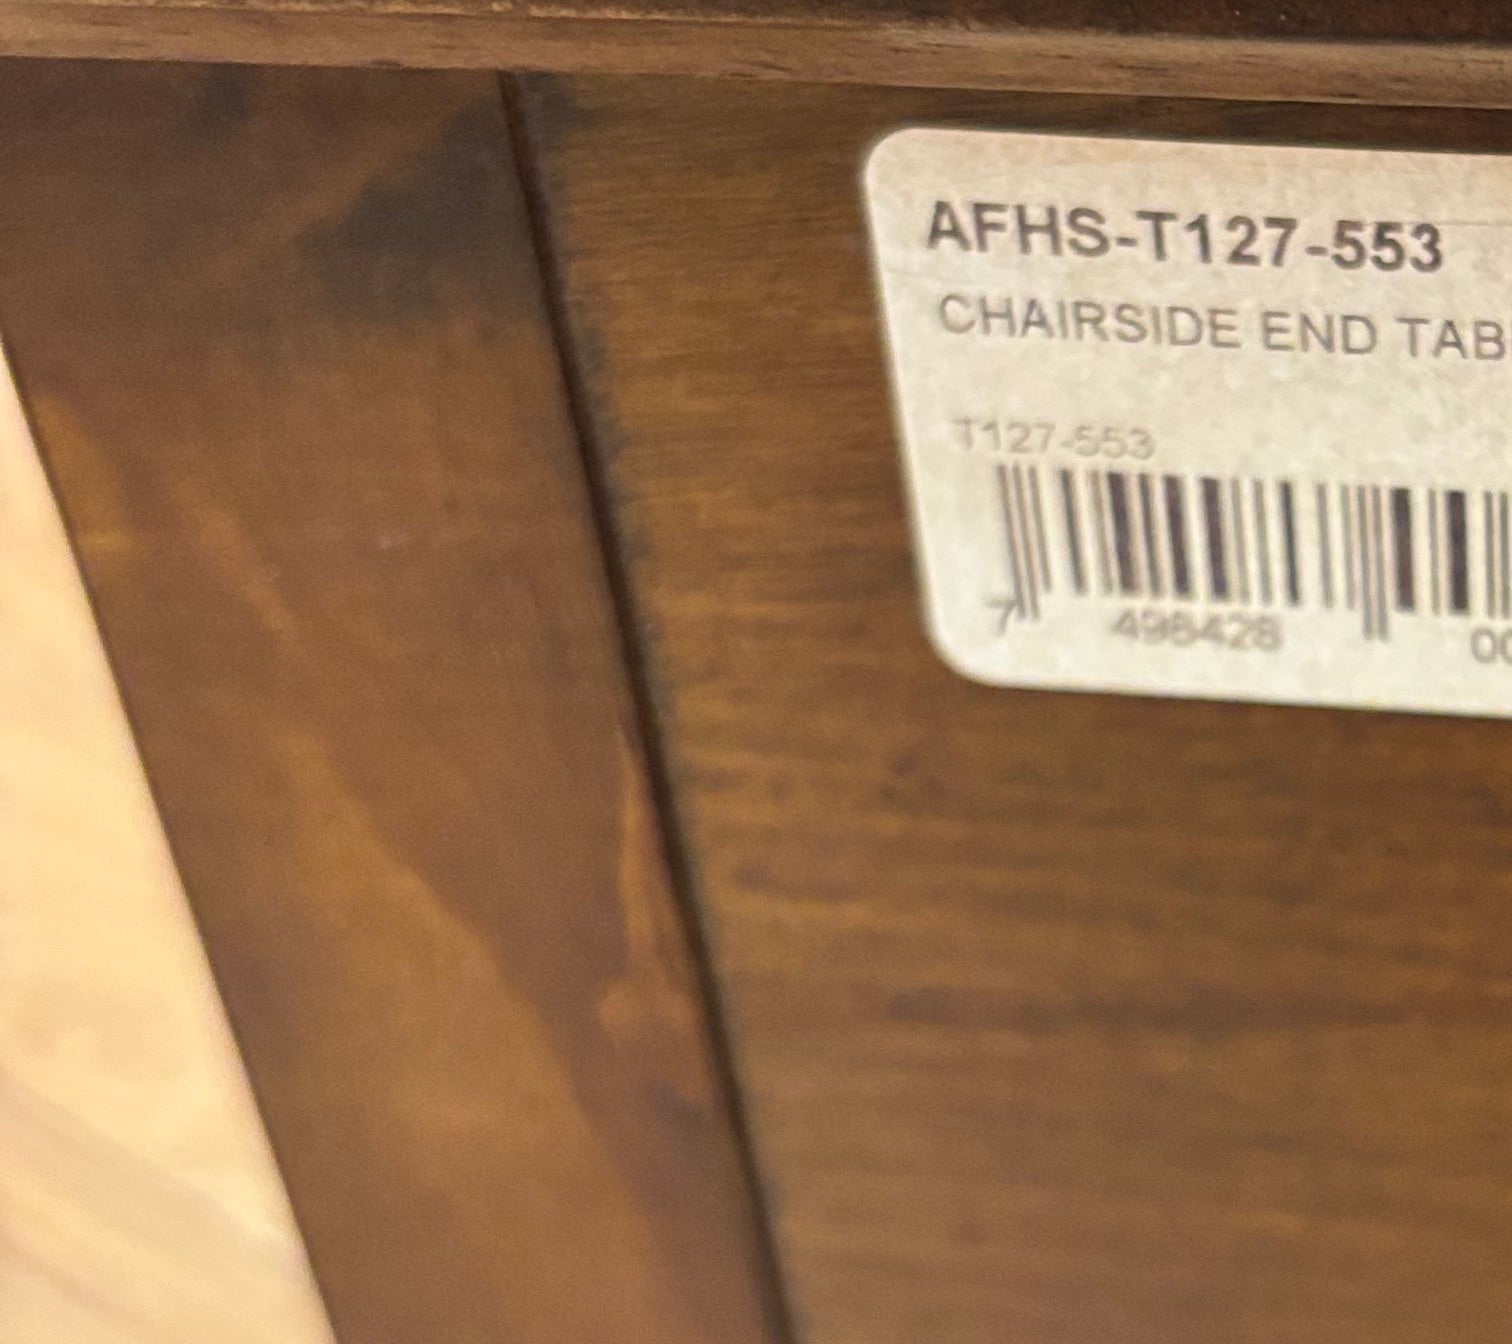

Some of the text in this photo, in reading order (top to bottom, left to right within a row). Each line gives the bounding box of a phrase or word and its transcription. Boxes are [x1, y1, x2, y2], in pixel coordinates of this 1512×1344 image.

[927, 200, 1444, 273] AFHS-T127-553
[938, 293, 1241, 350] CHAIRSIDE
[1262, 311, 1377, 356] END
[954, 416, 1155, 460] T127-553
